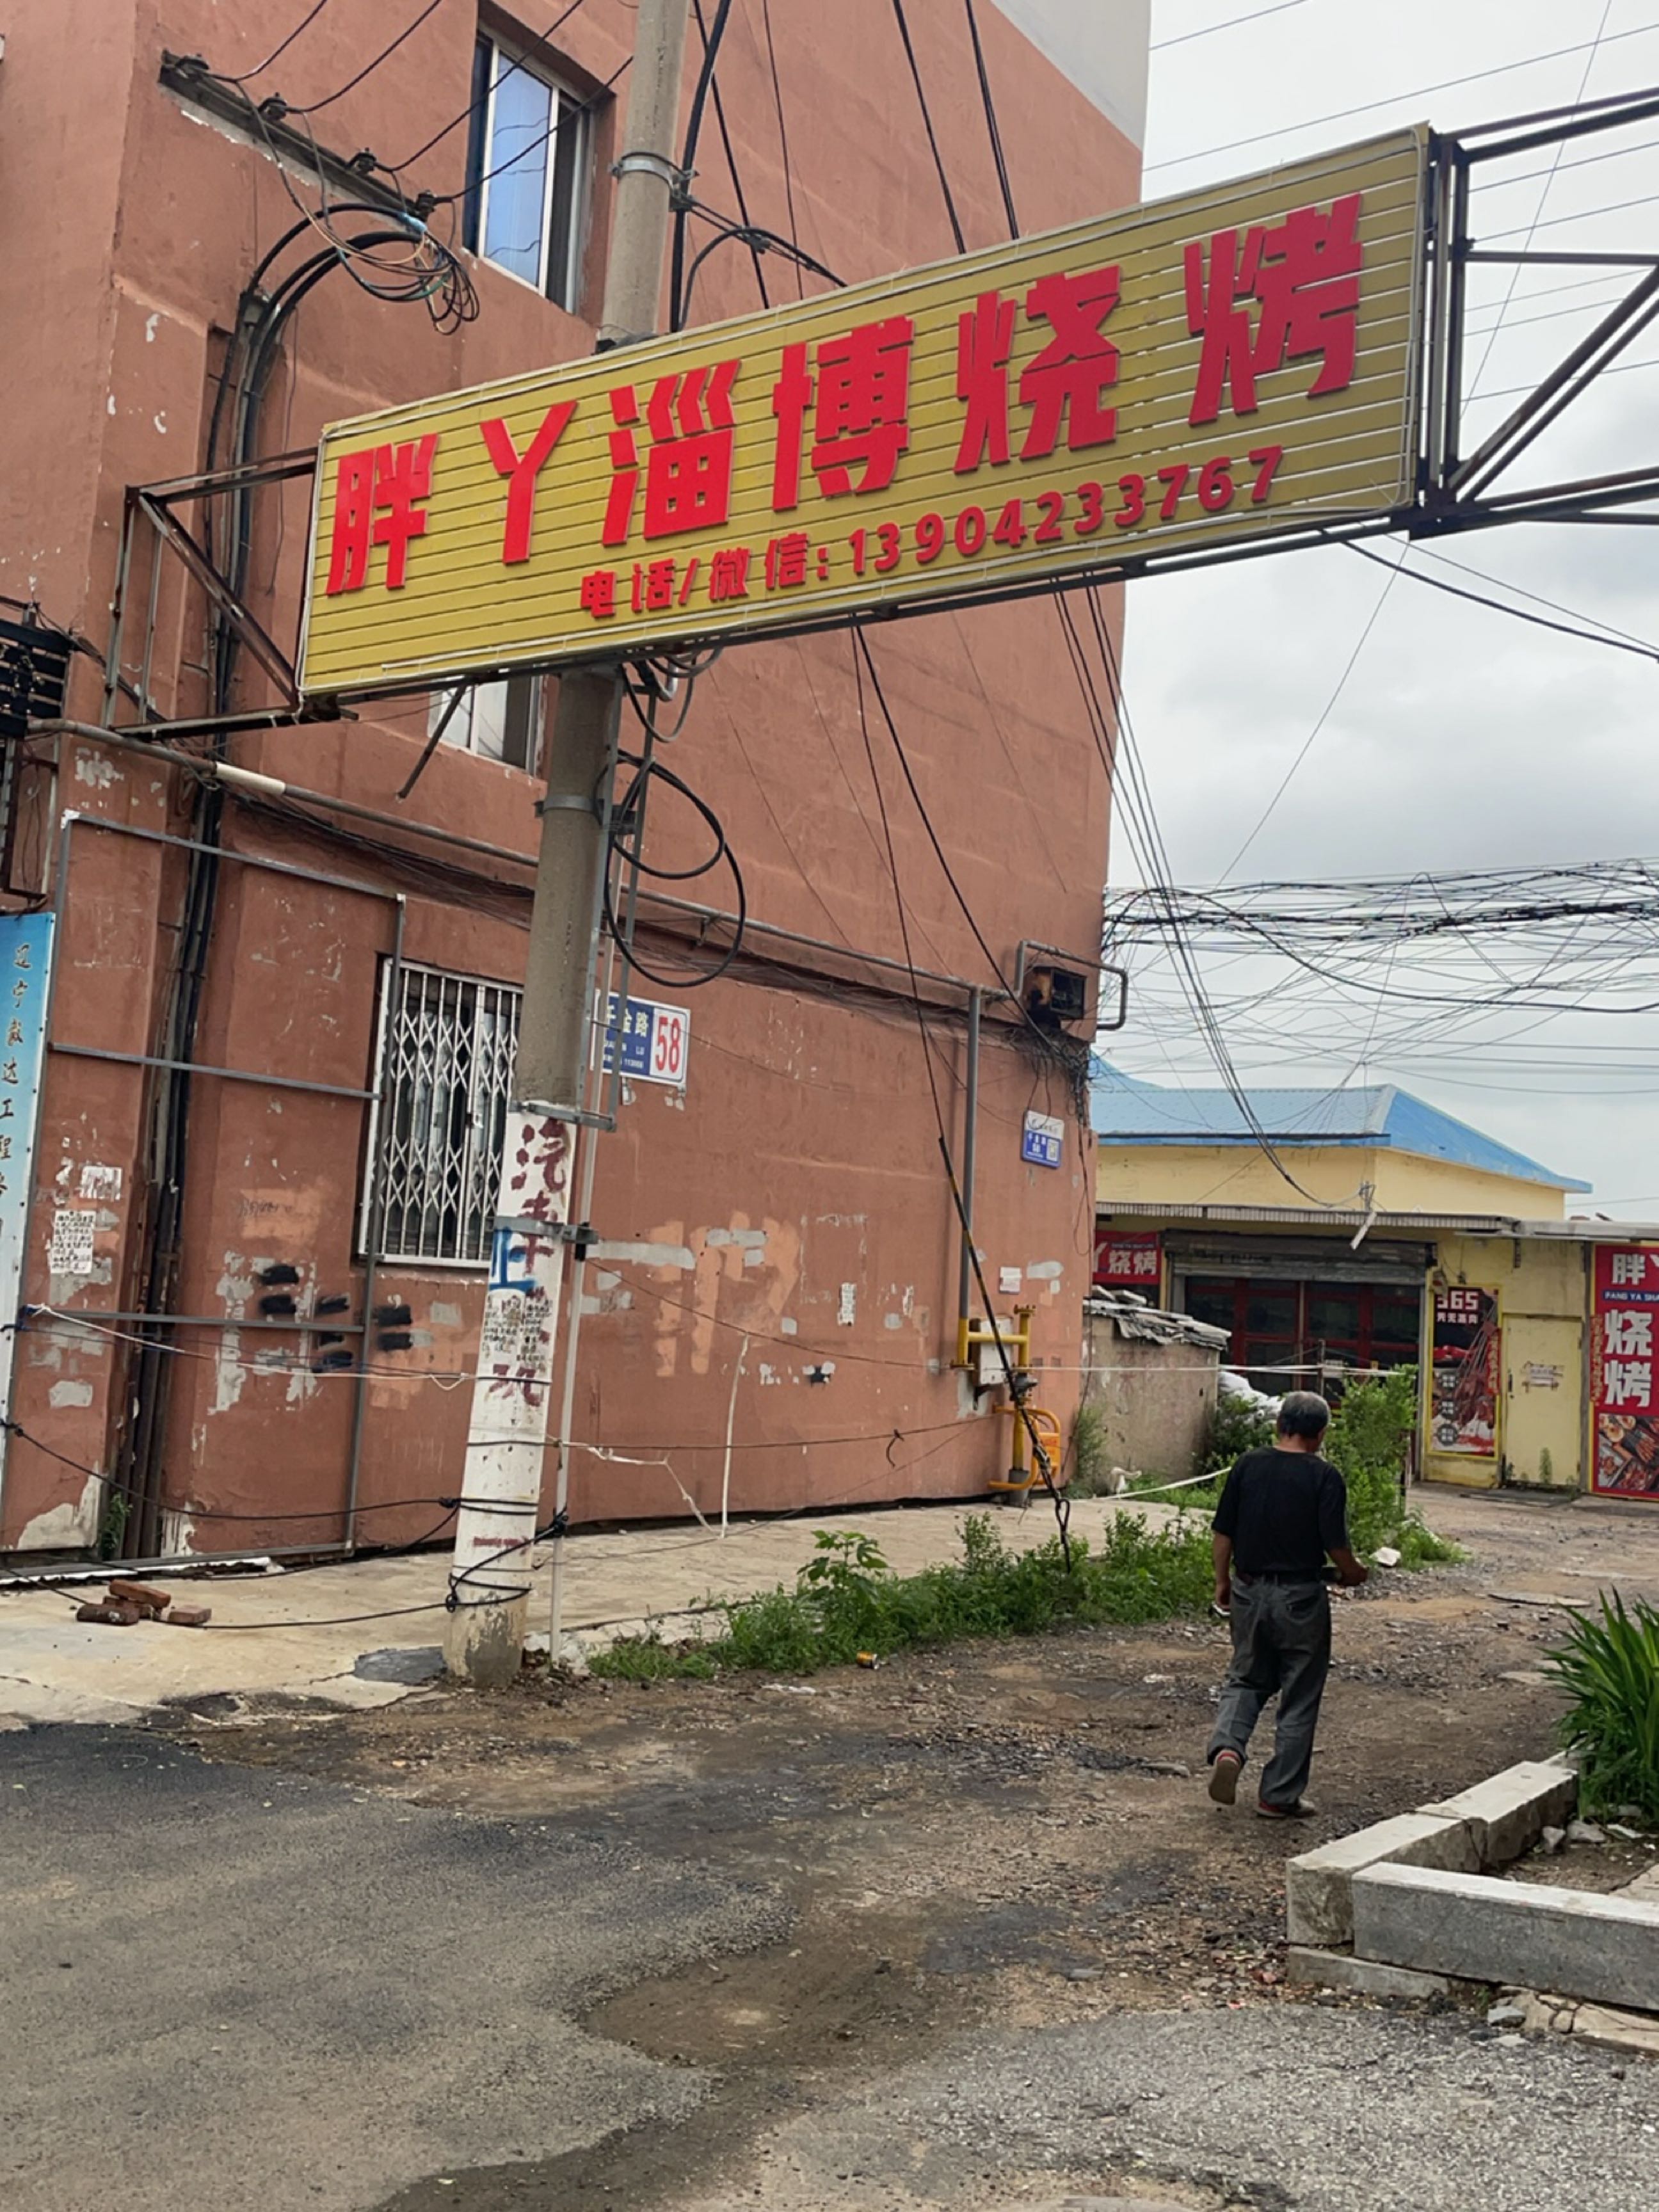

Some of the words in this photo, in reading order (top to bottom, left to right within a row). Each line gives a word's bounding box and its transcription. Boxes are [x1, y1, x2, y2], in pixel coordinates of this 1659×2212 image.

[325, 193, 1363, 596] 胖丫淄博烧烤
[655, 1015, 681, 1073] 58
[1604, 1308, 1653, 1407] 烧烤
